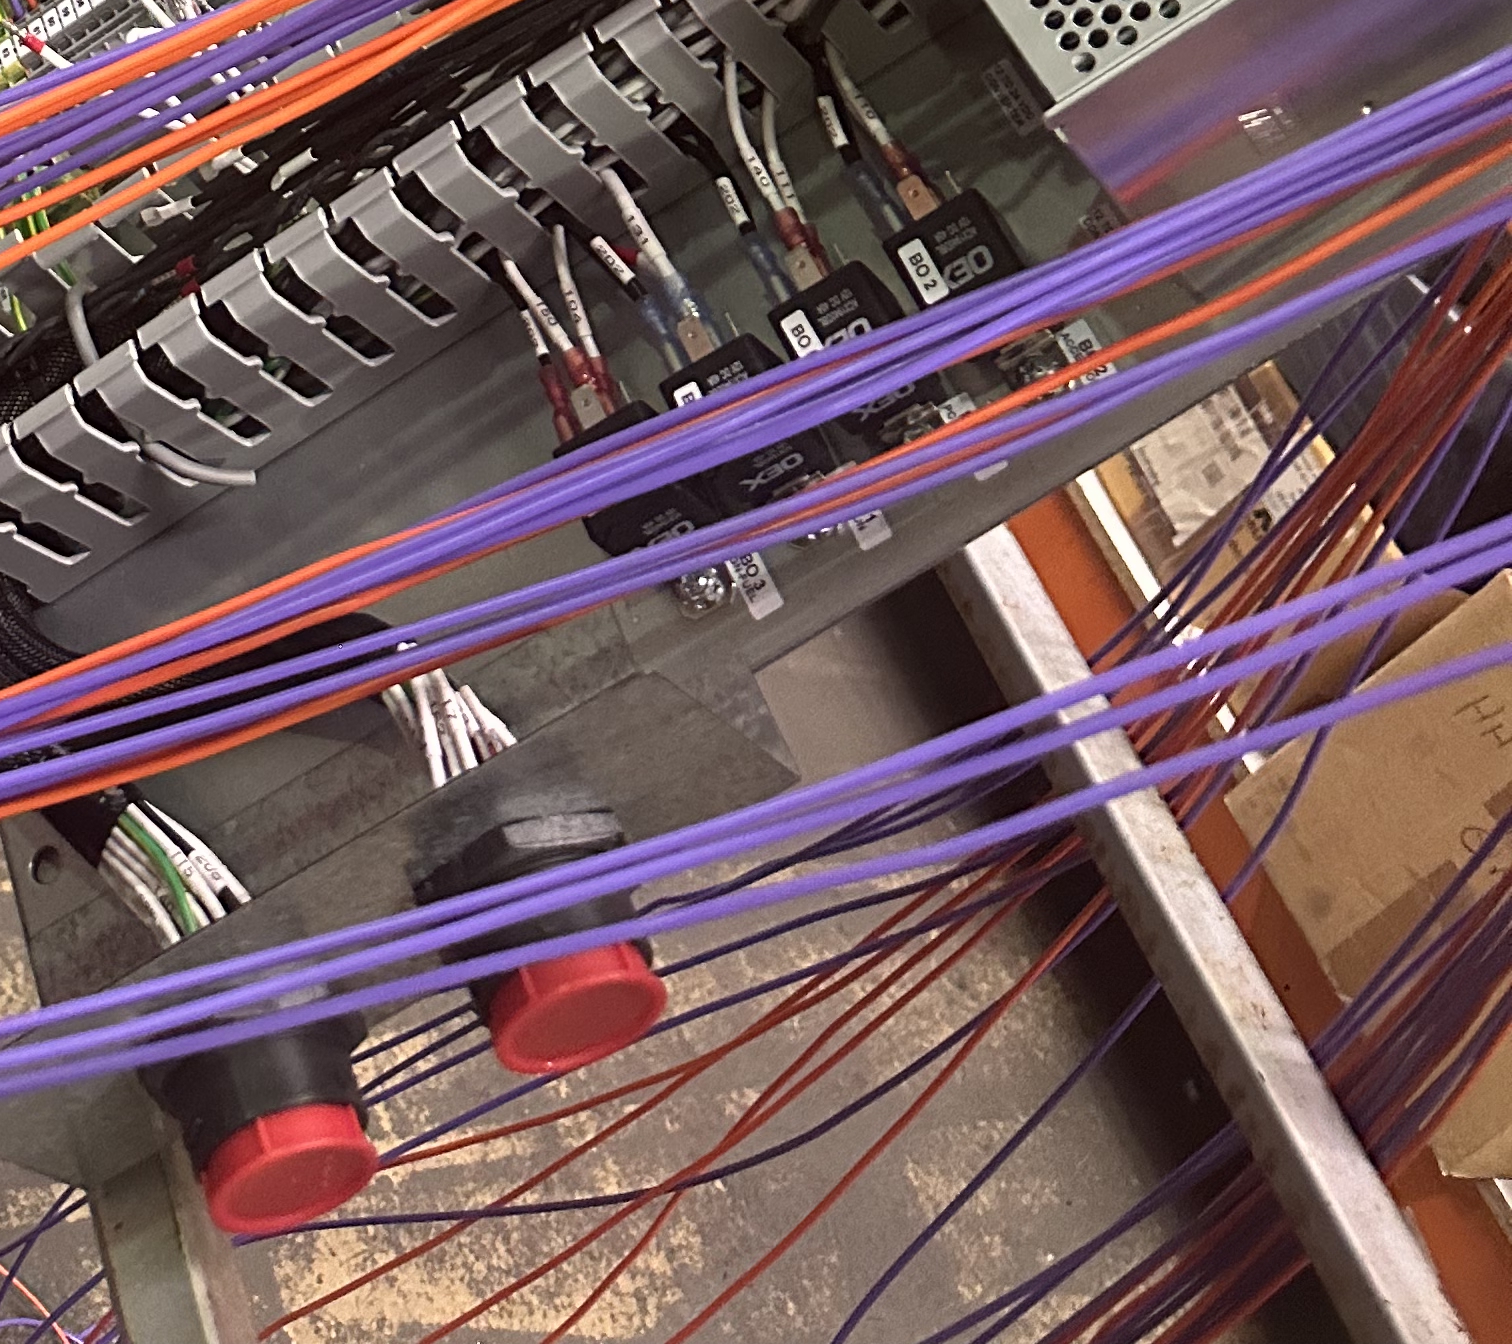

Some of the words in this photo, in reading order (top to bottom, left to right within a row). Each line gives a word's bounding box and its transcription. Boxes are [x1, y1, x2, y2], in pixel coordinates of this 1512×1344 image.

[597, 243, 622, 276] 202
[907, 251, 931, 278] BO
[922, 278, 937, 292] 2
[790, 323, 812, 348] BO
[740, 448, 803, 495] OEX
[737, 552, 761, 578] BO
[753, 578, 767, 591] 3
